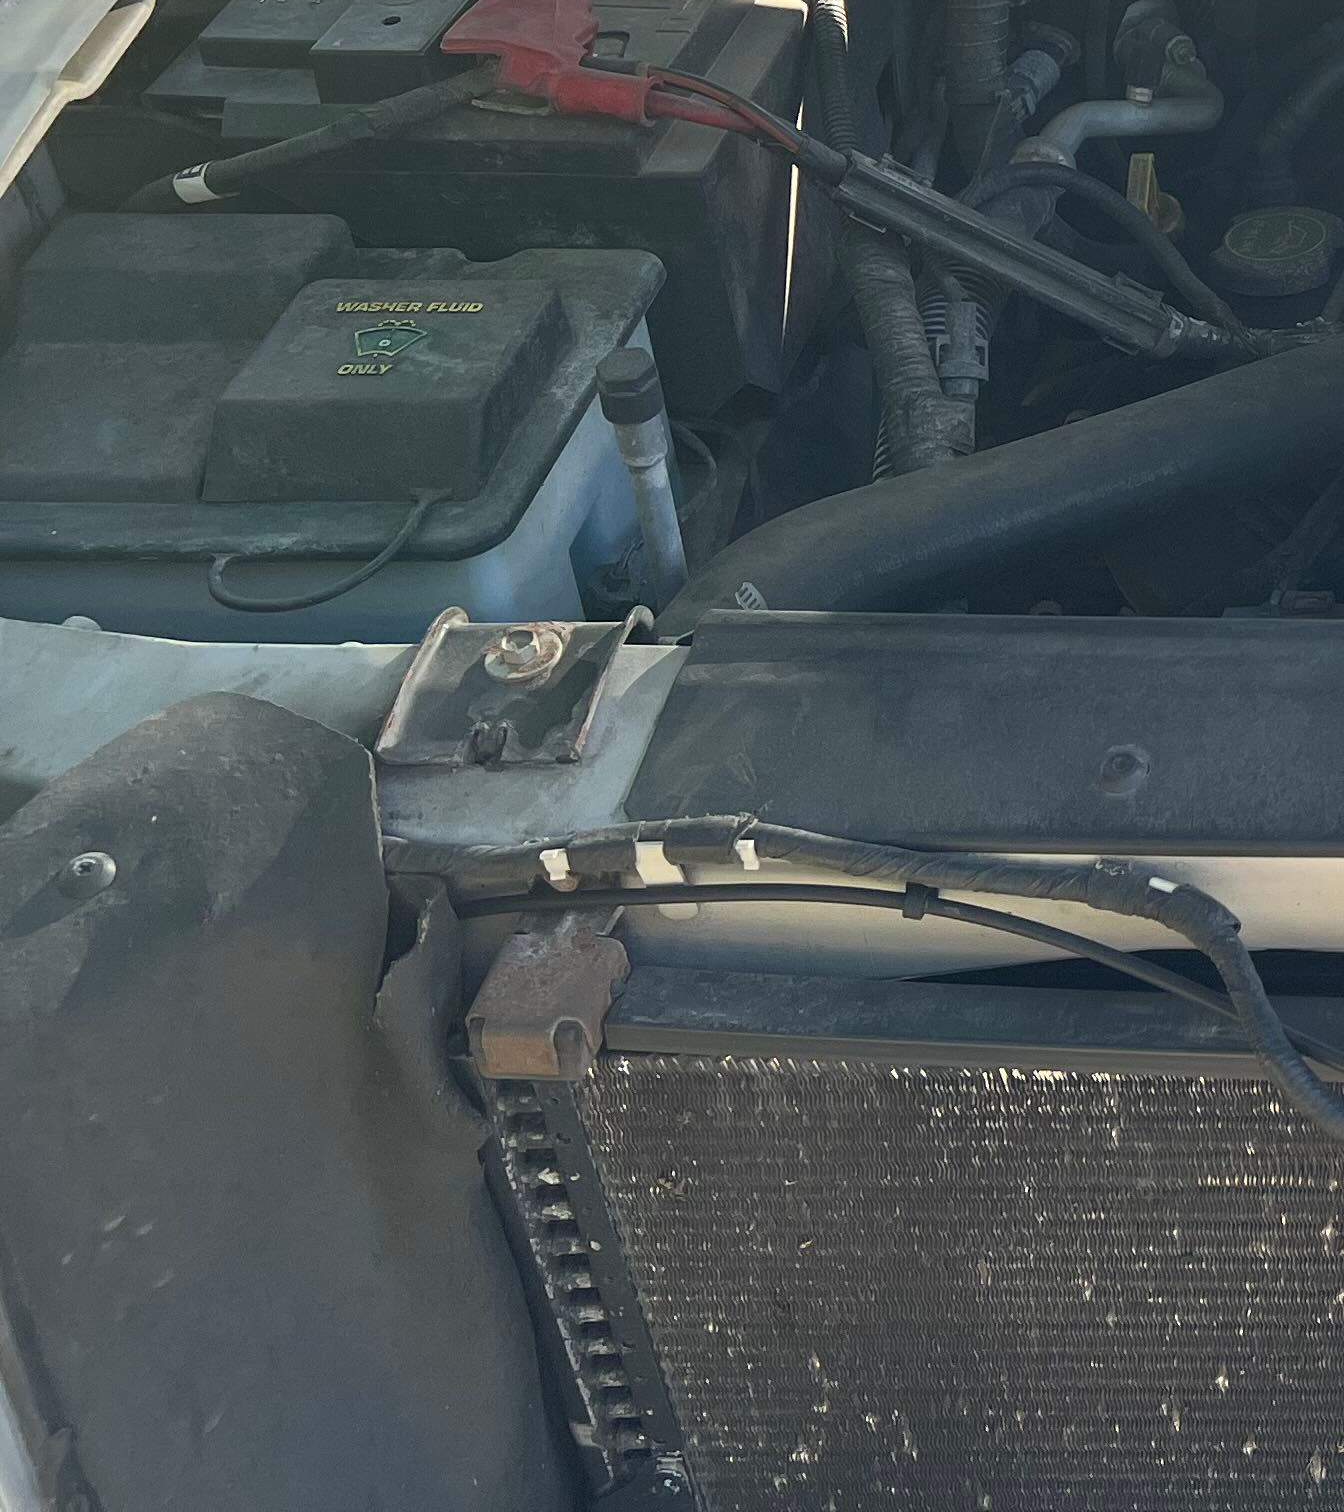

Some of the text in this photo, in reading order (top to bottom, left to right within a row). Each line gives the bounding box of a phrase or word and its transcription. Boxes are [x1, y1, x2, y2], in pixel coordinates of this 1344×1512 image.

[335, 301, 484, 313] WASHER FLUID
[337, 363, 395, 376] ONLY
